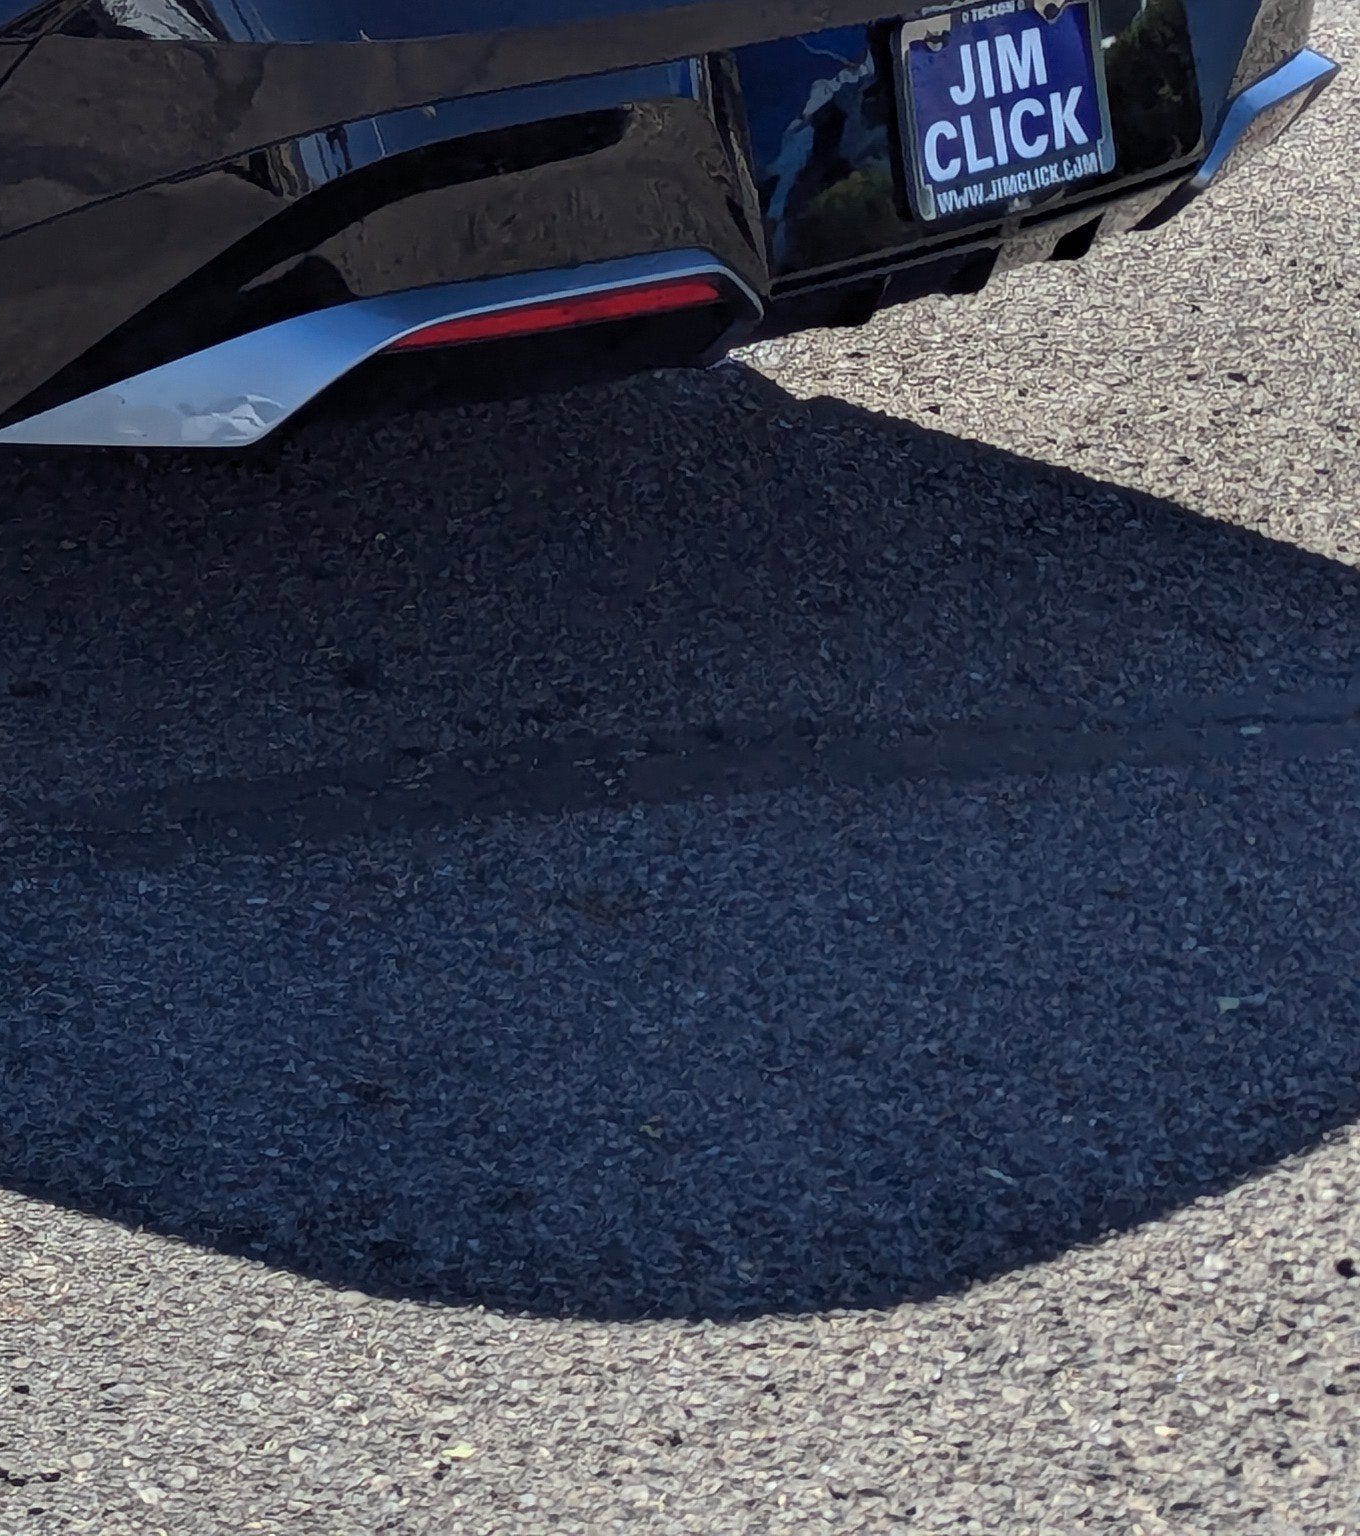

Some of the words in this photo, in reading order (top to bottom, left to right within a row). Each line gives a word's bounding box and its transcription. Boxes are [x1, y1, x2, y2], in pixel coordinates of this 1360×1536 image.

[949, 27, 1048, 106] JIM
[924, 85, 1089, 183] CLICK
[936, 151, 1100, 215] WWW.JIMCLICK.COM
